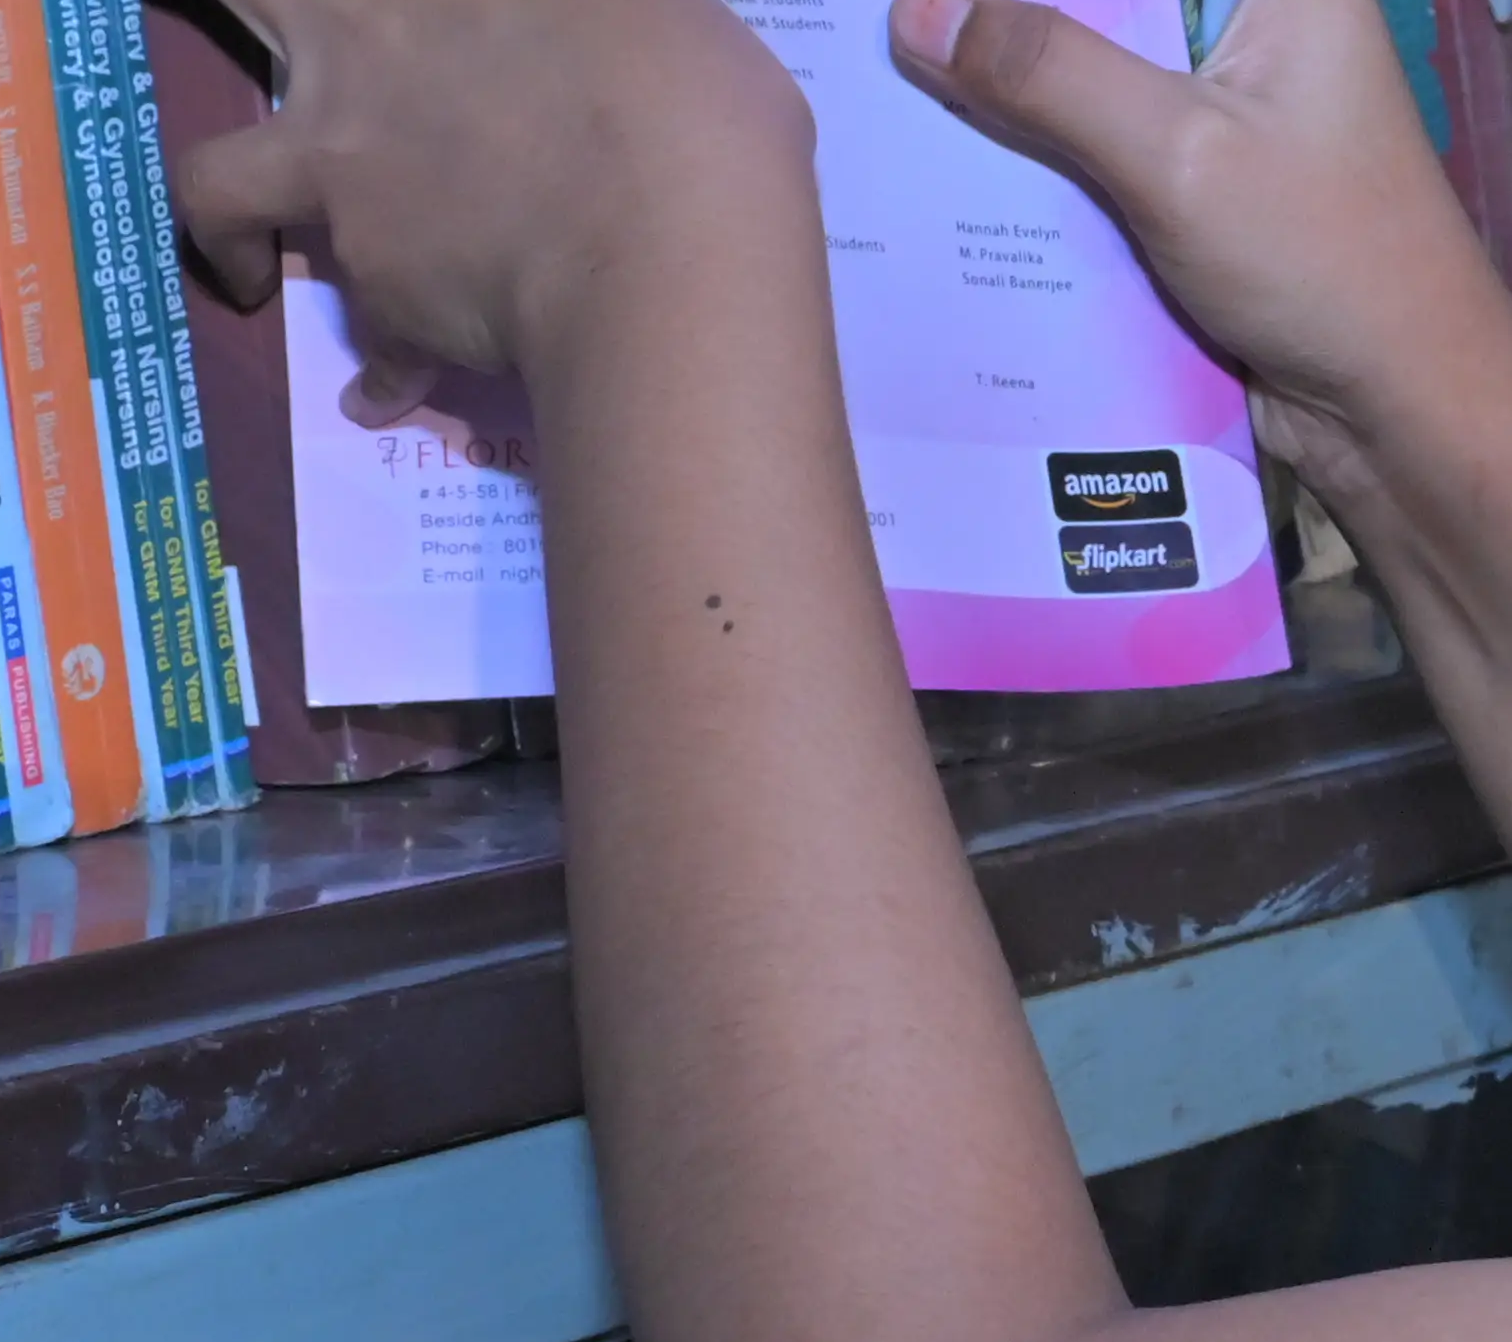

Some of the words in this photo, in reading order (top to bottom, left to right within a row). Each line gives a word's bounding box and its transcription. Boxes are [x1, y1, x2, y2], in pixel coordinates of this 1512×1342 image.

[99, 87, 119, 108] &
[101, 117, 154, 337] Gynecological
[955, 221, 1009, 237] Hannah
[1013, 224, 1061, 242] Evelyn
[960, 247, 975, 260] M.
[980, 248, 1043, 265] Pravalika
[962, 272, 1006, 288] Sonali
[1009, 276, 1072, 295] Banerjee
[992, 374, 1035, 390] Reena
[138, 343, 168, 466] Nursing
[417, 438, 531, 468] FLOR
[437, 485, 498, 499] 4-5-58
[1064, 470, 1169, 496] amazon
[159, 497, 175, 529] for
[420, 513, 485, 528] Beside
[492, 513, 542, 525] Andh
[166, 538, 187, 598] GNM
[1080, 543, 1167, 572] flipkart
[423, 568, 484, 582] E-mail
[500, 567, 541, 583] nigh
[0, 577, 20, 650] PARAS
[176, 603, 196, 666] Third
[186, 673, 203, 723] Year
[13, 666, 37, 780] PUBLISHING
